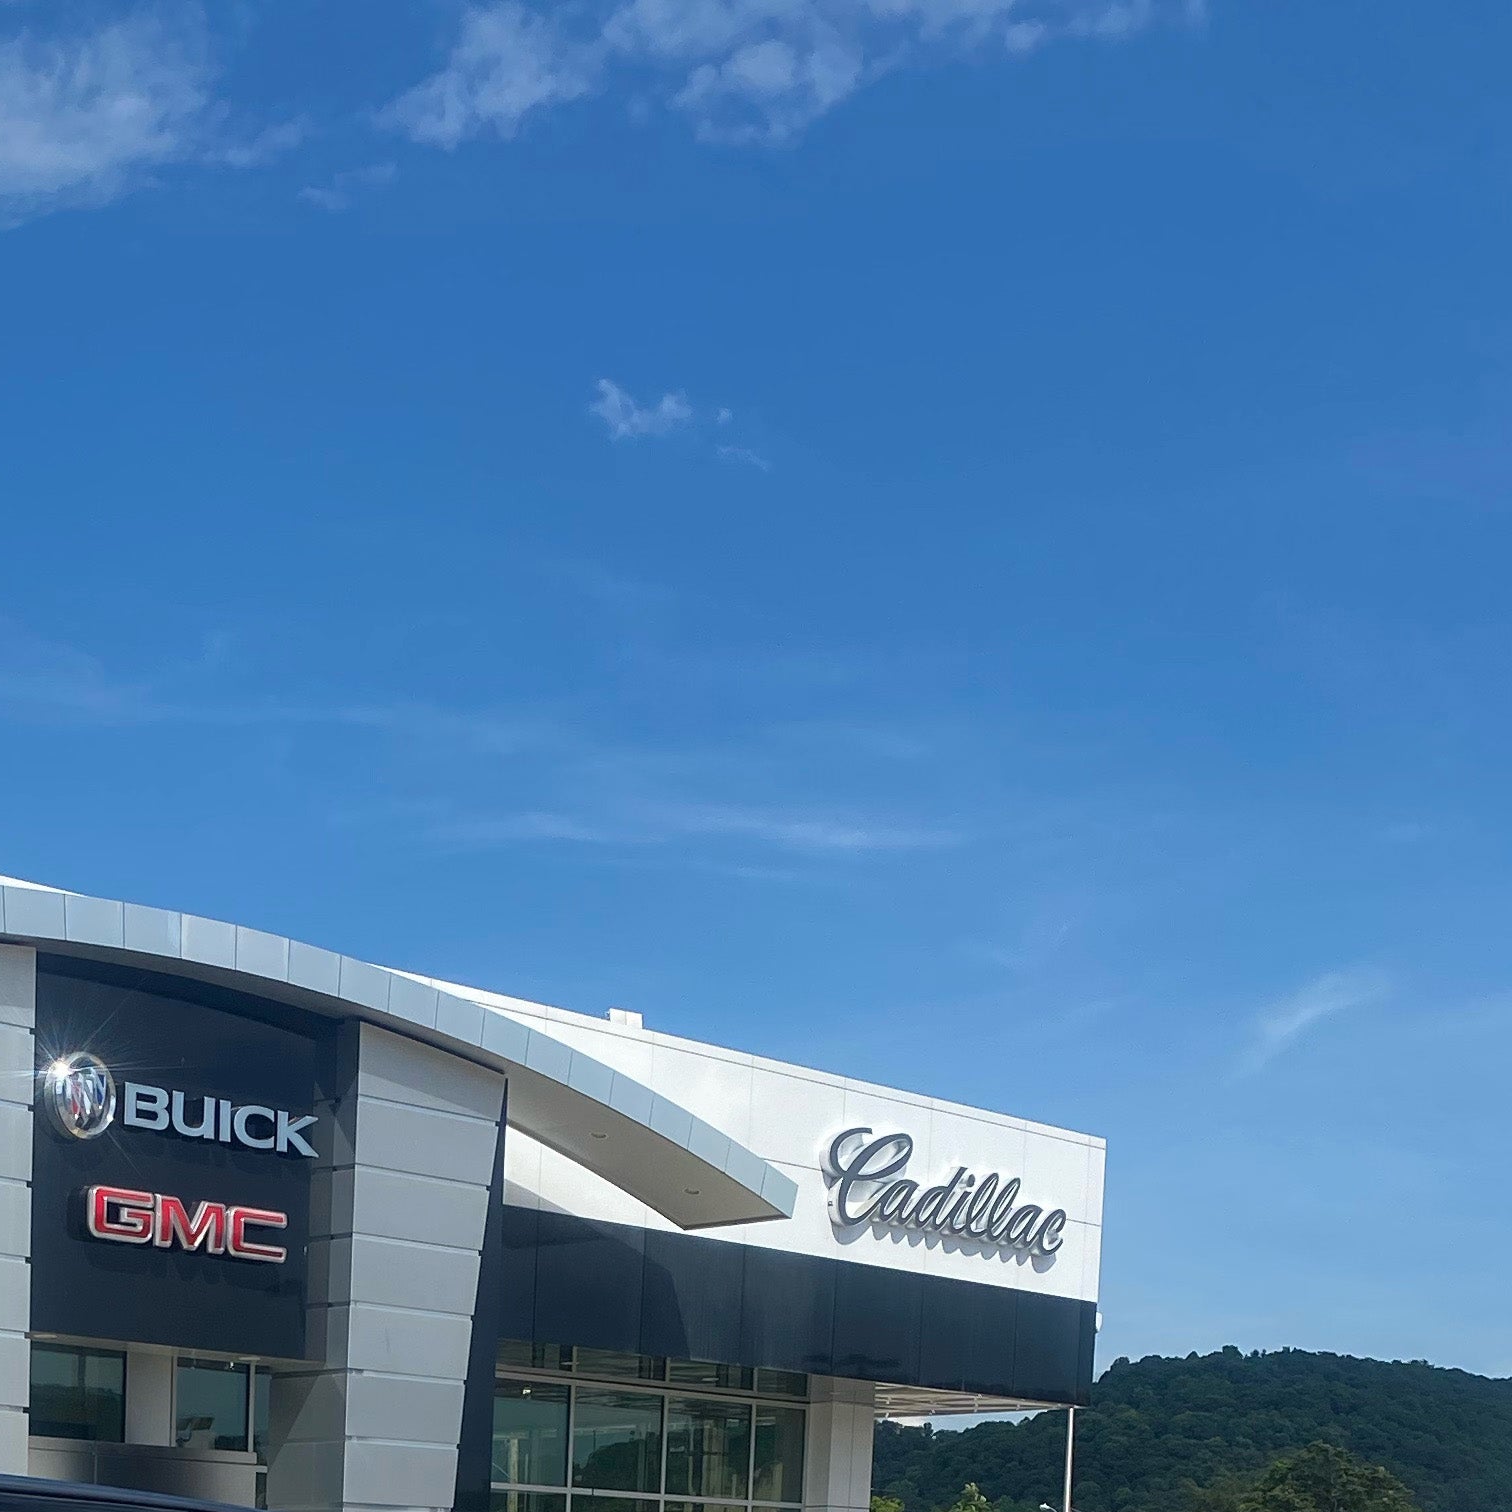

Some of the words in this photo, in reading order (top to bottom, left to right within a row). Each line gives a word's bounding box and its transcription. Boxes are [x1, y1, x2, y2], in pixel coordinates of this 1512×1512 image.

[124, 1081, 319, 1158] BUICK
[87, 1185, 288, 1263] GMC
[824, 1126, 1067, 1256] Cadillac
